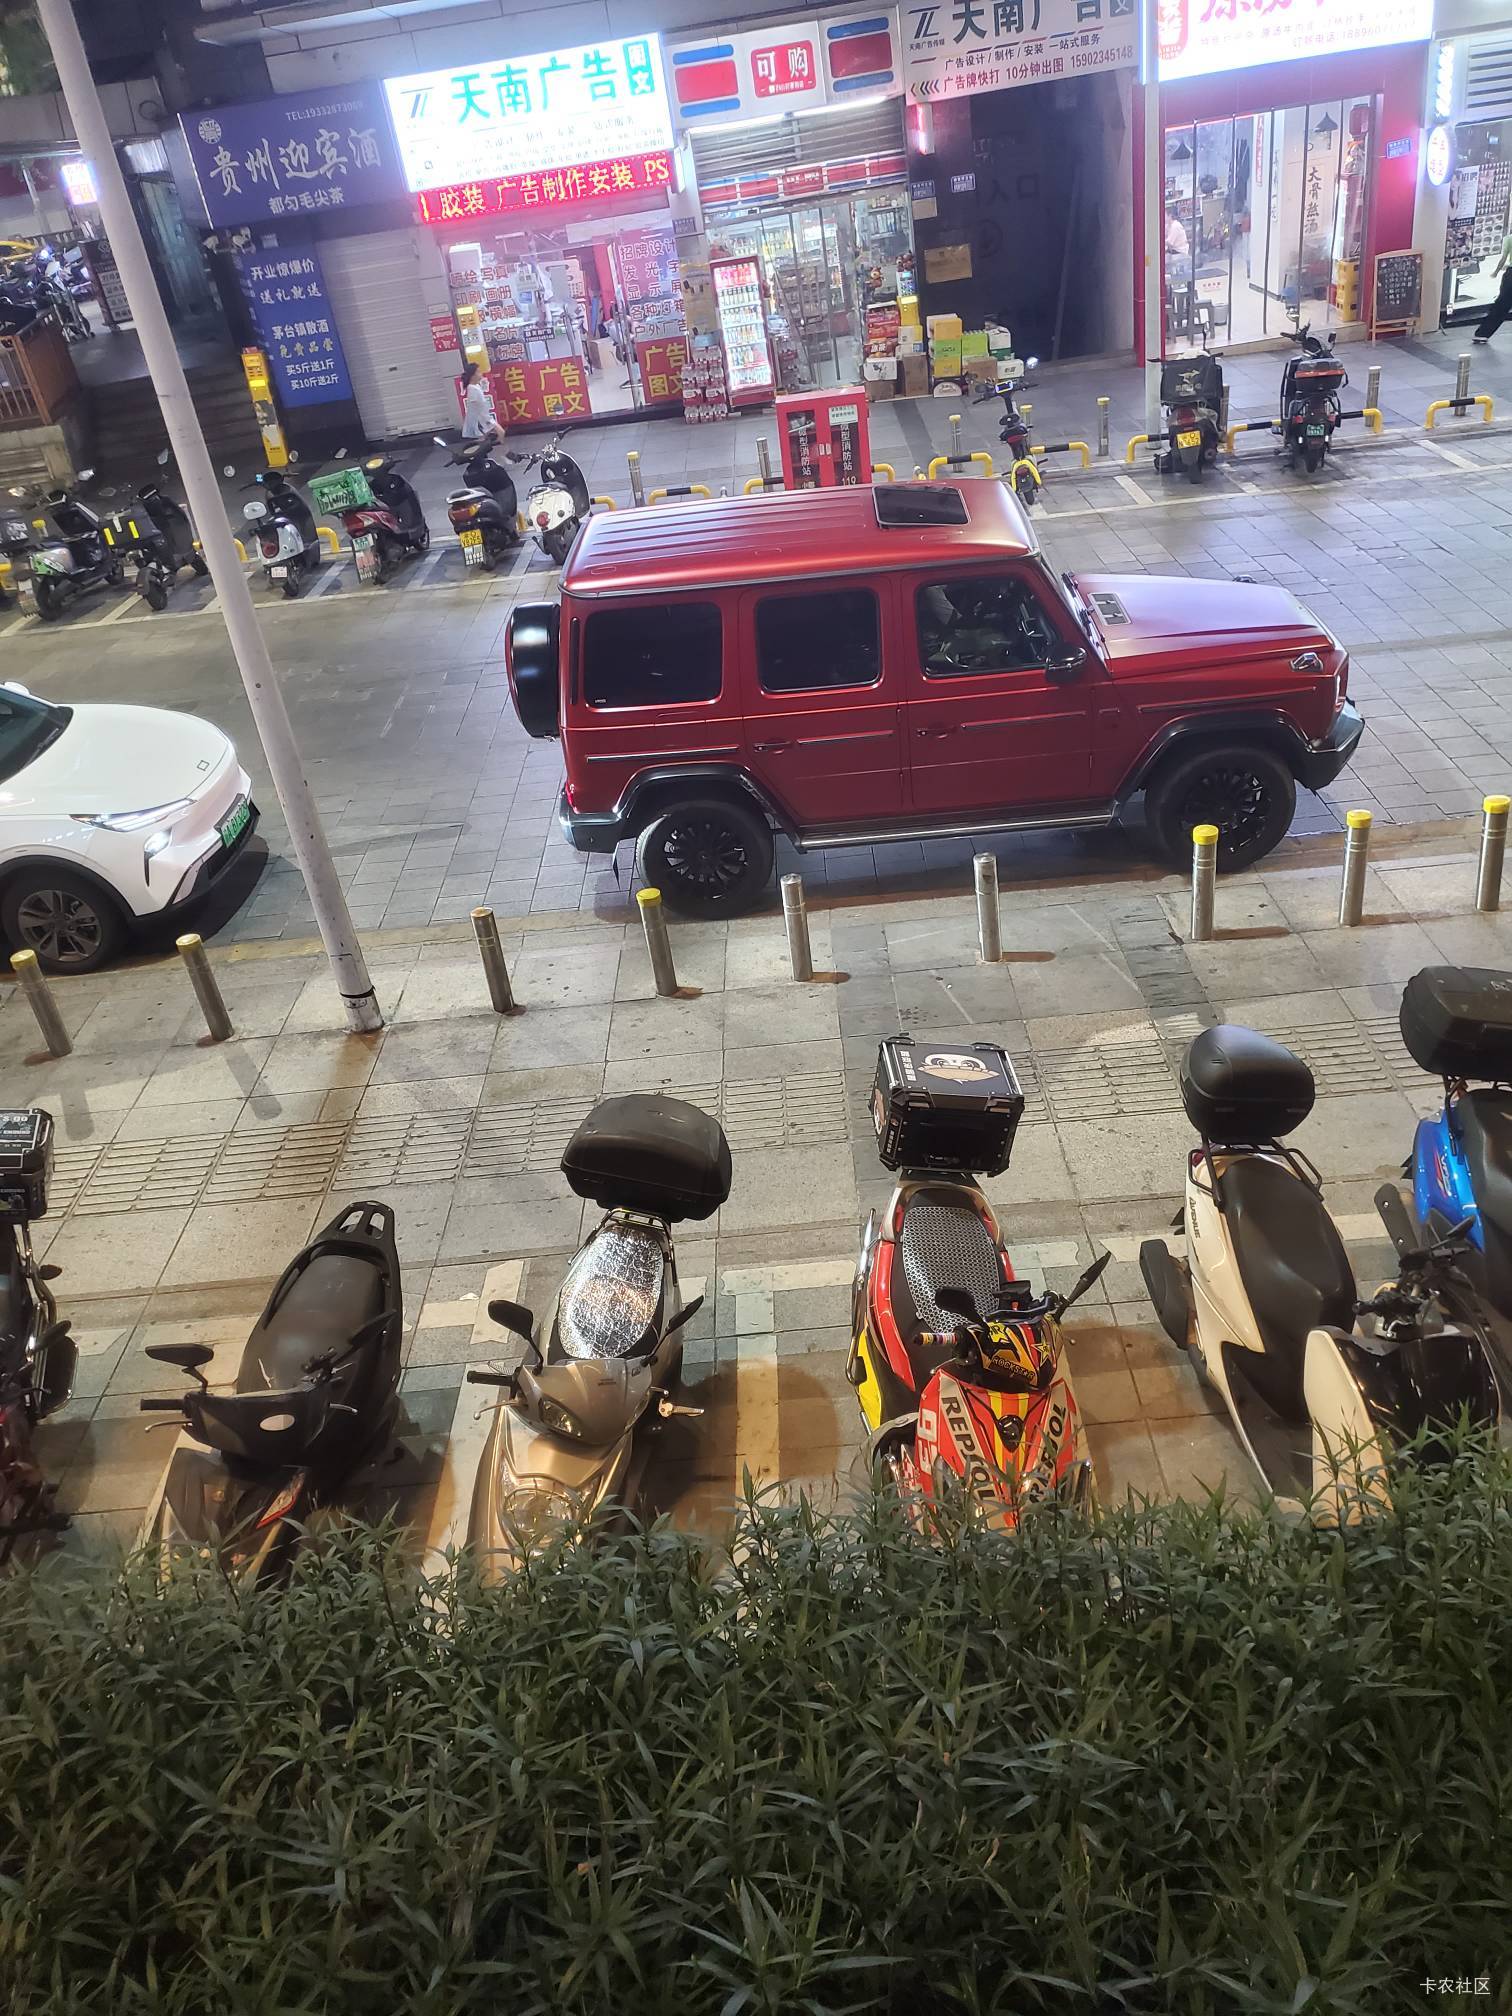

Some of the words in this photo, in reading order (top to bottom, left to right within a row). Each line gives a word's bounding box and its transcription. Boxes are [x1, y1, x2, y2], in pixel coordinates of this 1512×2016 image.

[1049, 33, 1101, 51] 一站式服务
[756, 46, 809, 83] 可购
[943, 69, 1000, 92] 广告牌快打
[1006, 57, 1064, 80] 10分钟出图
[1071, 46, 1133, 69] 15902345148
[451, 49, 617, 124] 天南广告
[209, 127, 381, 196] 贵州迎宾酒
[440, 186, 485, 218] 胶装
[497, 162, 634, 210] 广告制作安装
[643, 158, 669, 183] PS
[1304, 166, 1322, 234] 大骨熬汤
[268, 186, 345, 215] 都匀毛尖茶
[619, 238, 677, 261] 招牌设计
[251, 258, 315, 282] 开业惊爆价
[481, 265, 509, 281] 写真
[623, 259, 681, 281] 发光字
[259, 281, 323, 305] 送礼就送
[486, 285, 512, 302] 画册
[629, 299, 686, 321] 各种灯箱
[271, 319, 330, 340] 茅台镇散酒
[634, 318, 688, 338] 户外广告
[286, 358, 335, 376] 买5斤送1斤
[645, 343, 686, 372] 广告
[290, 373, 340, 390] 买10斤送2斤
[539, 363, 581, 391] 广告
[543, 390, 586, 417] 图文
[842, 476, 857, 486] 119
